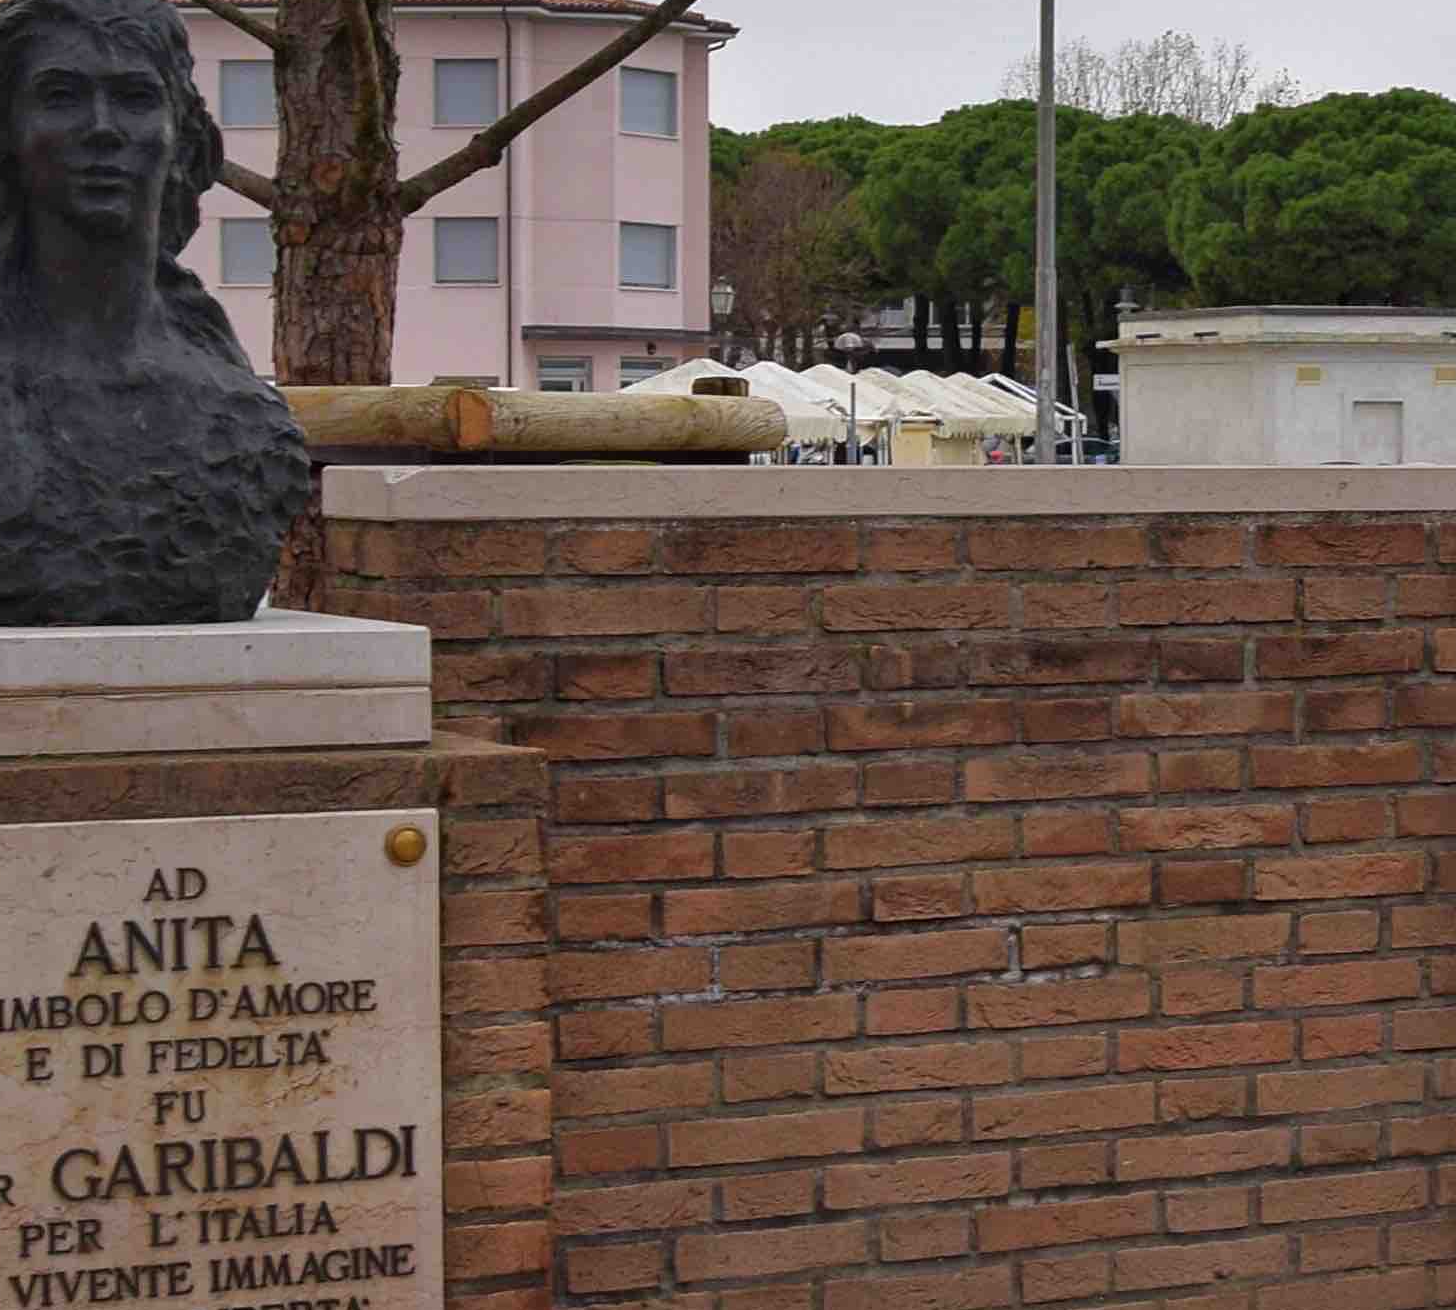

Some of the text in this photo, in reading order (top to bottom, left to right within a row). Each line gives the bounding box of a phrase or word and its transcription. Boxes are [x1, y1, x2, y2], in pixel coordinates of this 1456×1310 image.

[143, 867, 208, 903] AD
[69, 914, 280, 978] ANITA
[188, 980, 376, 1023] D'AMORE
[26, 1047, 53, 1082] E
[83, 1043, 124, 1079] DI
[152, 1091, 207, 1126] FU
[52, 1125, 418, 1203] GARIBALDI
[19, 1220, 103, 1258] PER
[9, 1262, 194, 1309] VIVENTE
[209, 1245, 415, 1293] IMMAGINE
